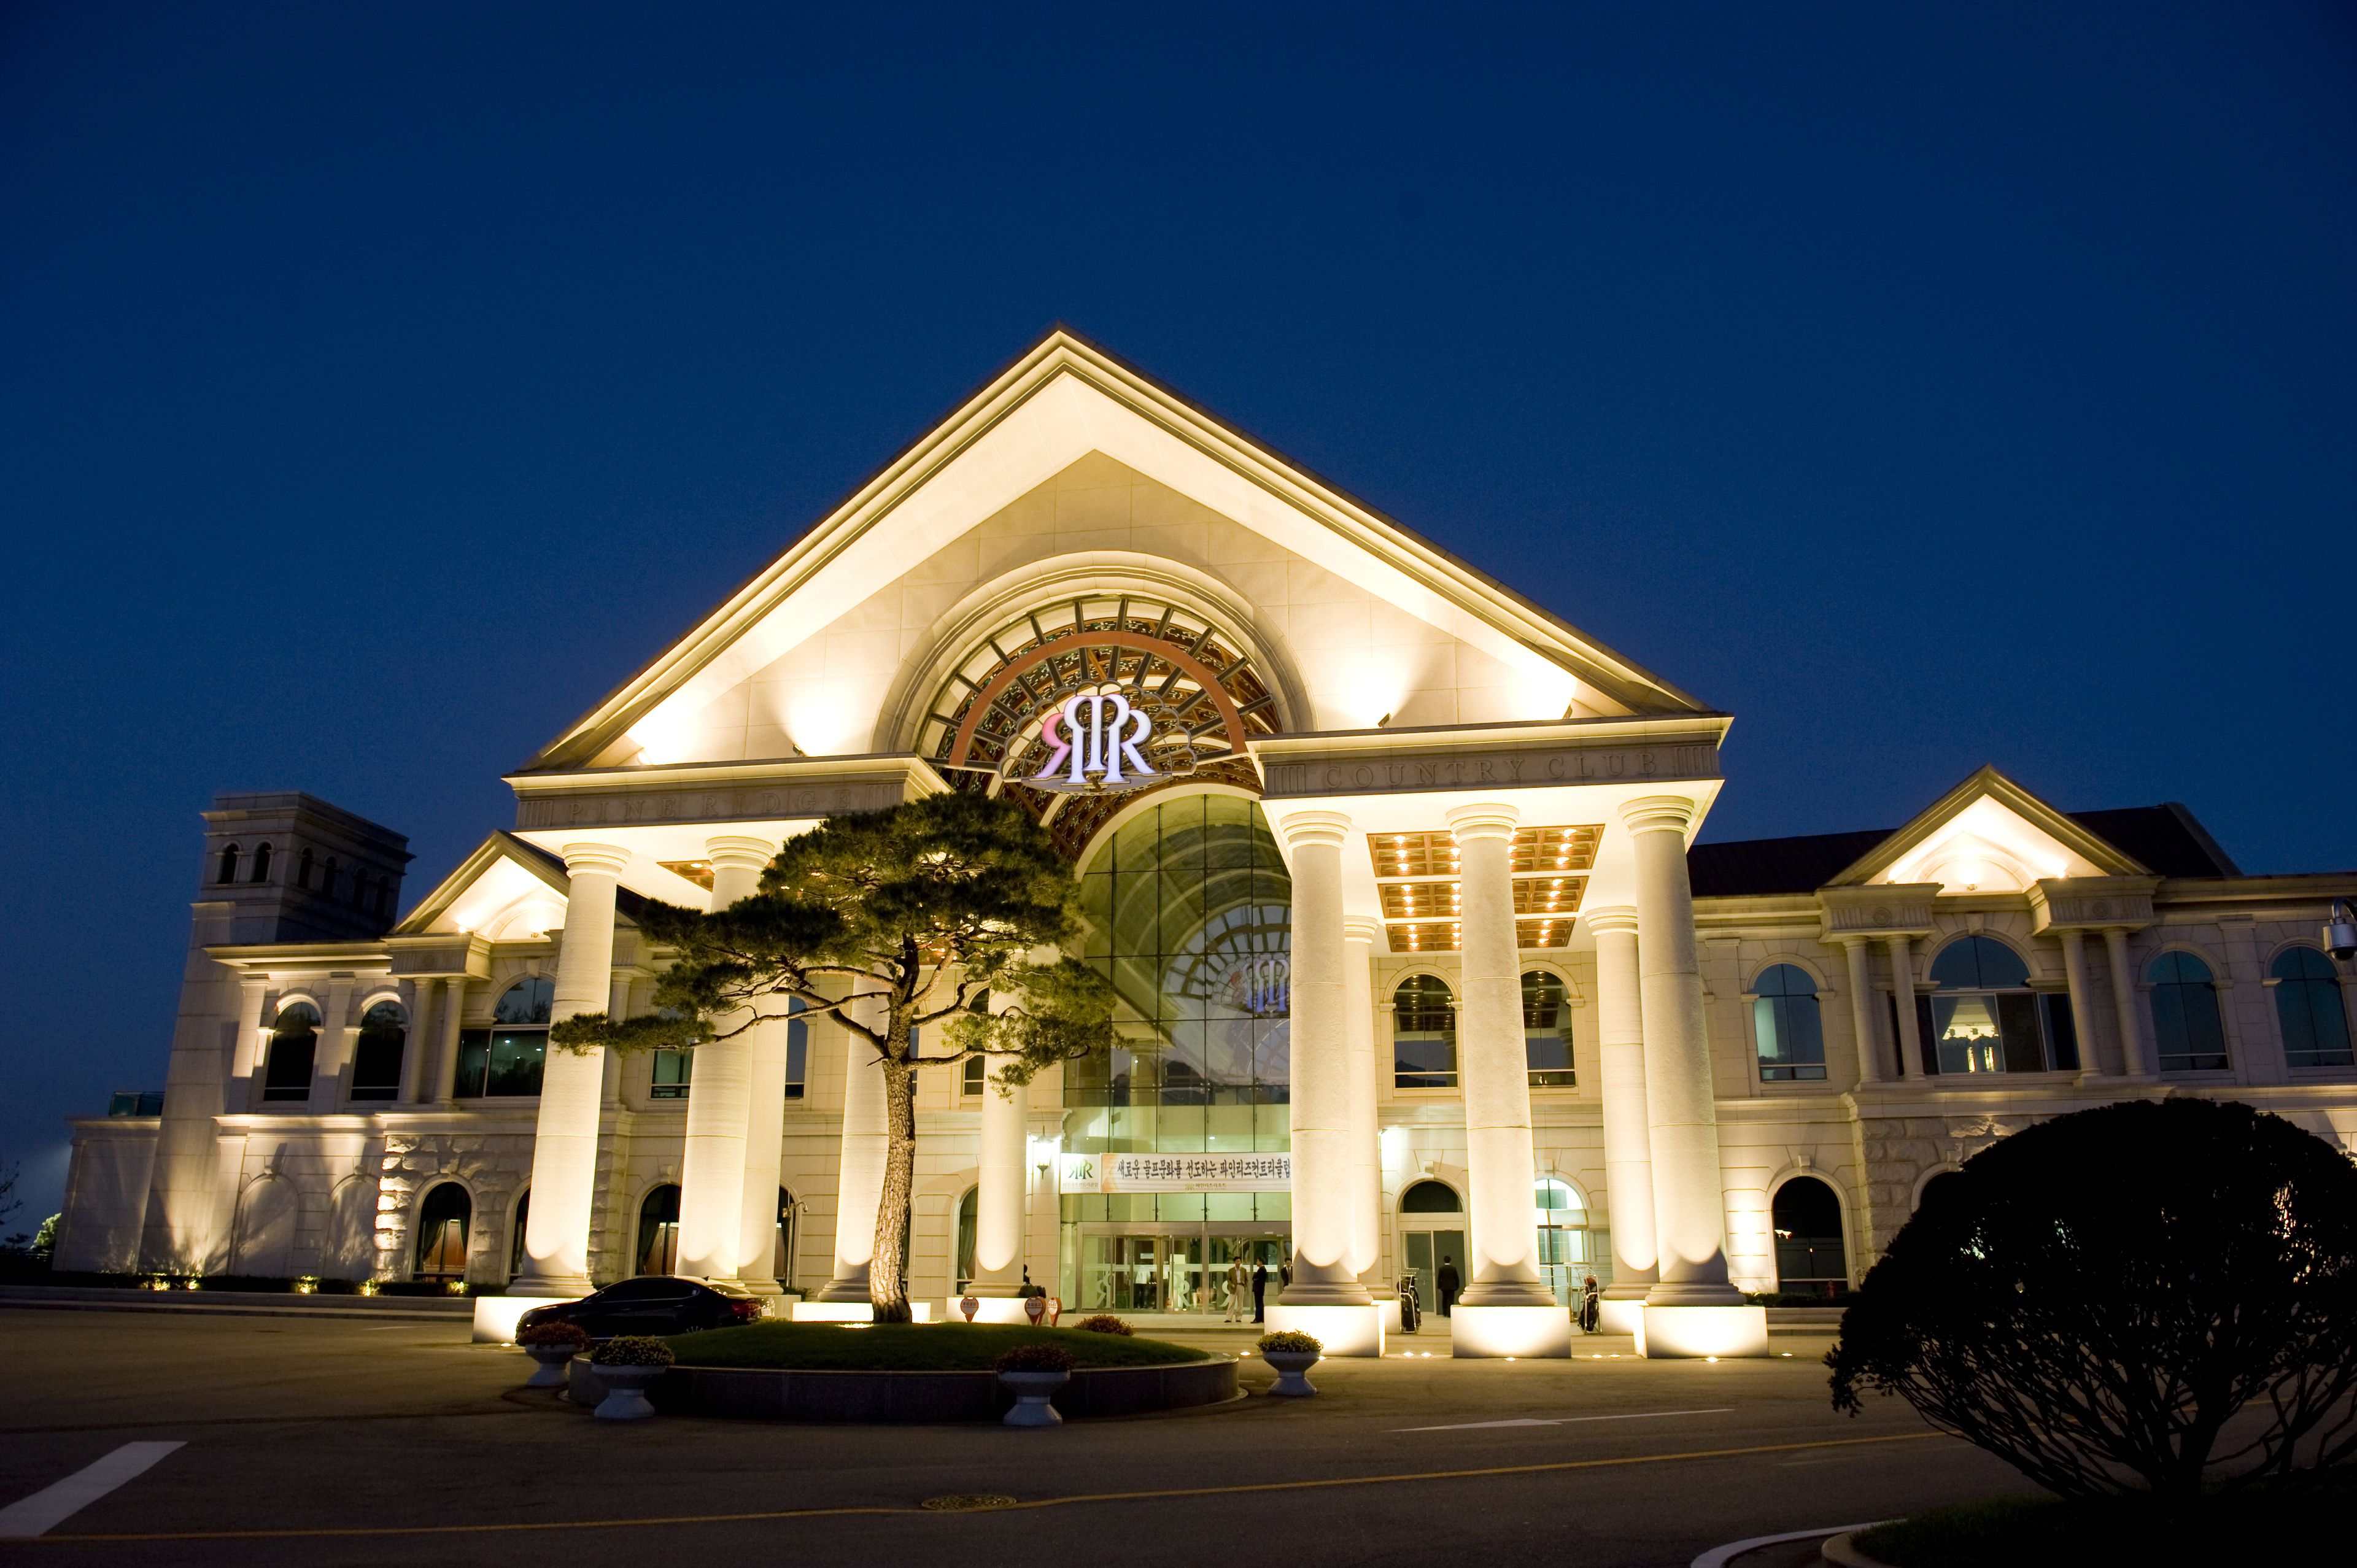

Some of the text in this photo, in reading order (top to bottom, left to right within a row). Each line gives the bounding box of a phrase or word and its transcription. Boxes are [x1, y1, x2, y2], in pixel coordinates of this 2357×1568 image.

[1326, 752, 1656, 788] COUNTRY CLUB
[567, 789, 851, 821] PINE RIDGE
[1117, 1158, 1290, 1179] 새로운 골프문화를 선도하는 파인리즈컨트리클럽
